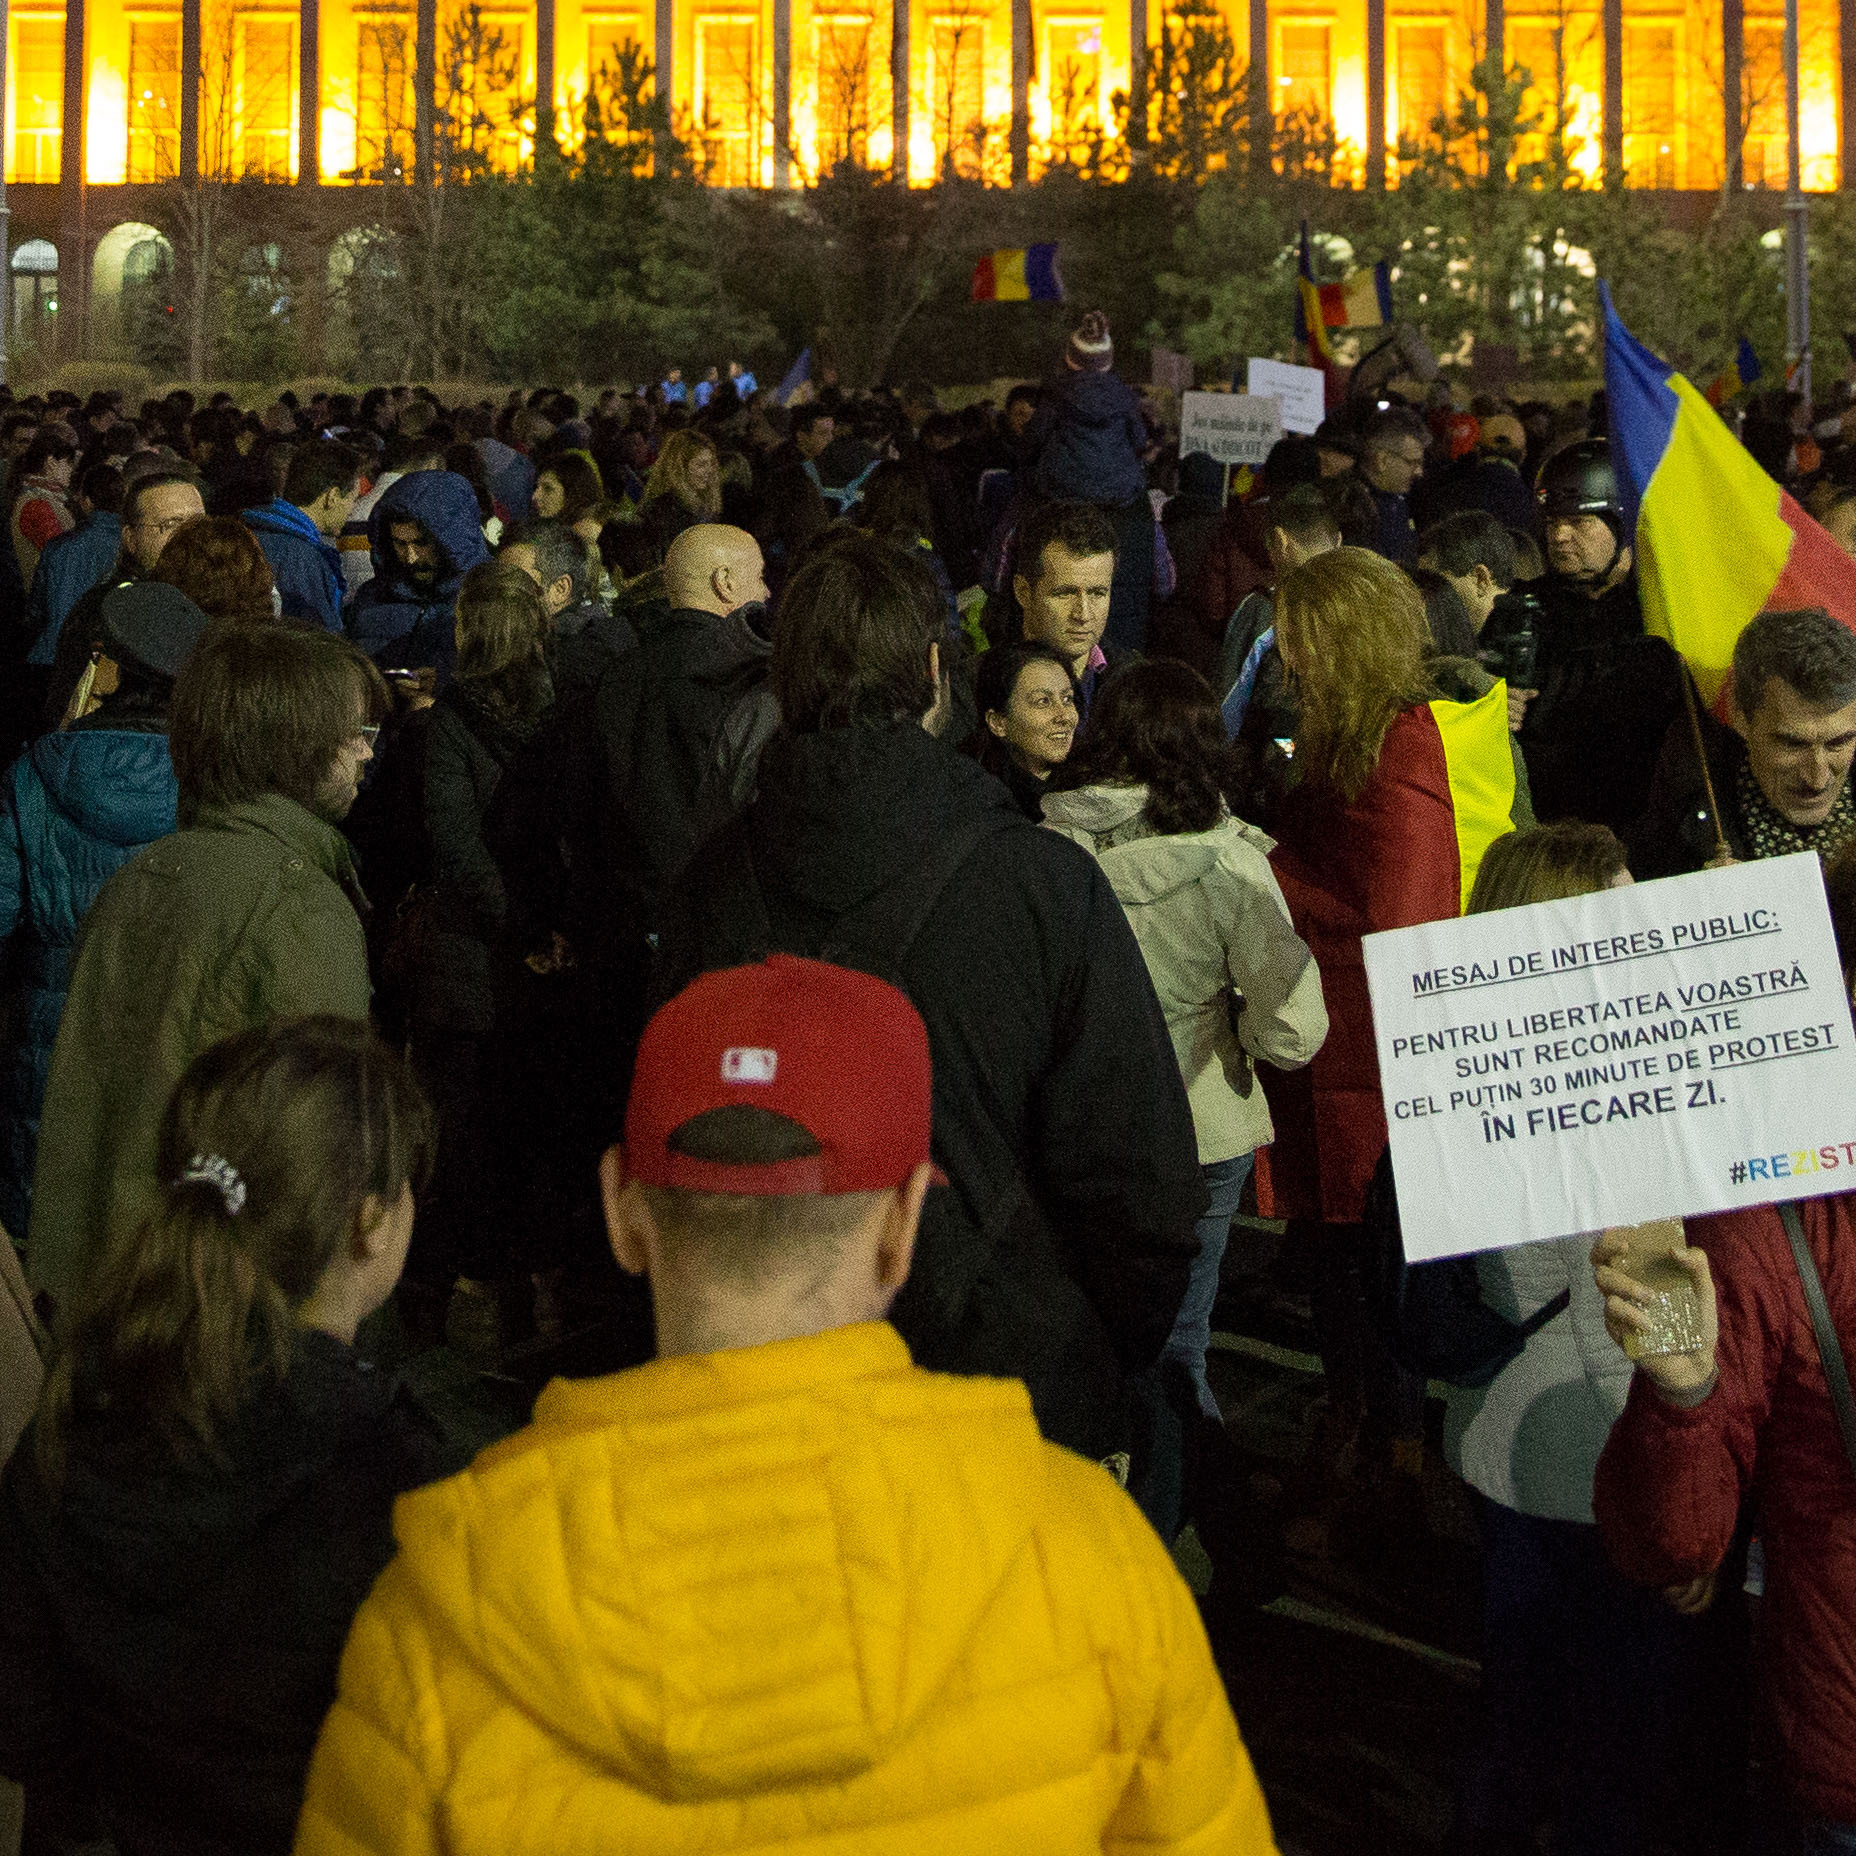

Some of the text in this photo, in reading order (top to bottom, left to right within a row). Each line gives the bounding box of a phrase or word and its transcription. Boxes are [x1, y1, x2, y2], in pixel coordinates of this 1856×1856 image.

[1411, 908, 1779, 993] MESAJ DE INTERES PUBLIC:
[1391, 959, 1808, 1059] PENTRU LIBERTATEA VOASTRĂ
[1454, 1008, 1741, 1078] SUNT RECOMANDATE
[1393, 1094, 1443, 1120] CEL
[1529, 1073, 1557, 1096] 30
[1563, 1056, 1660, 1091] MINUTE
[1665, 1048, 1702, 1073] DE
[1707, 1022, 1834, 1065] PROTEST
[1479, 1078, 1726, 1144] ÎN FIECARE ZI.
[1728, 1141, 1856, 1185] #REZIST
